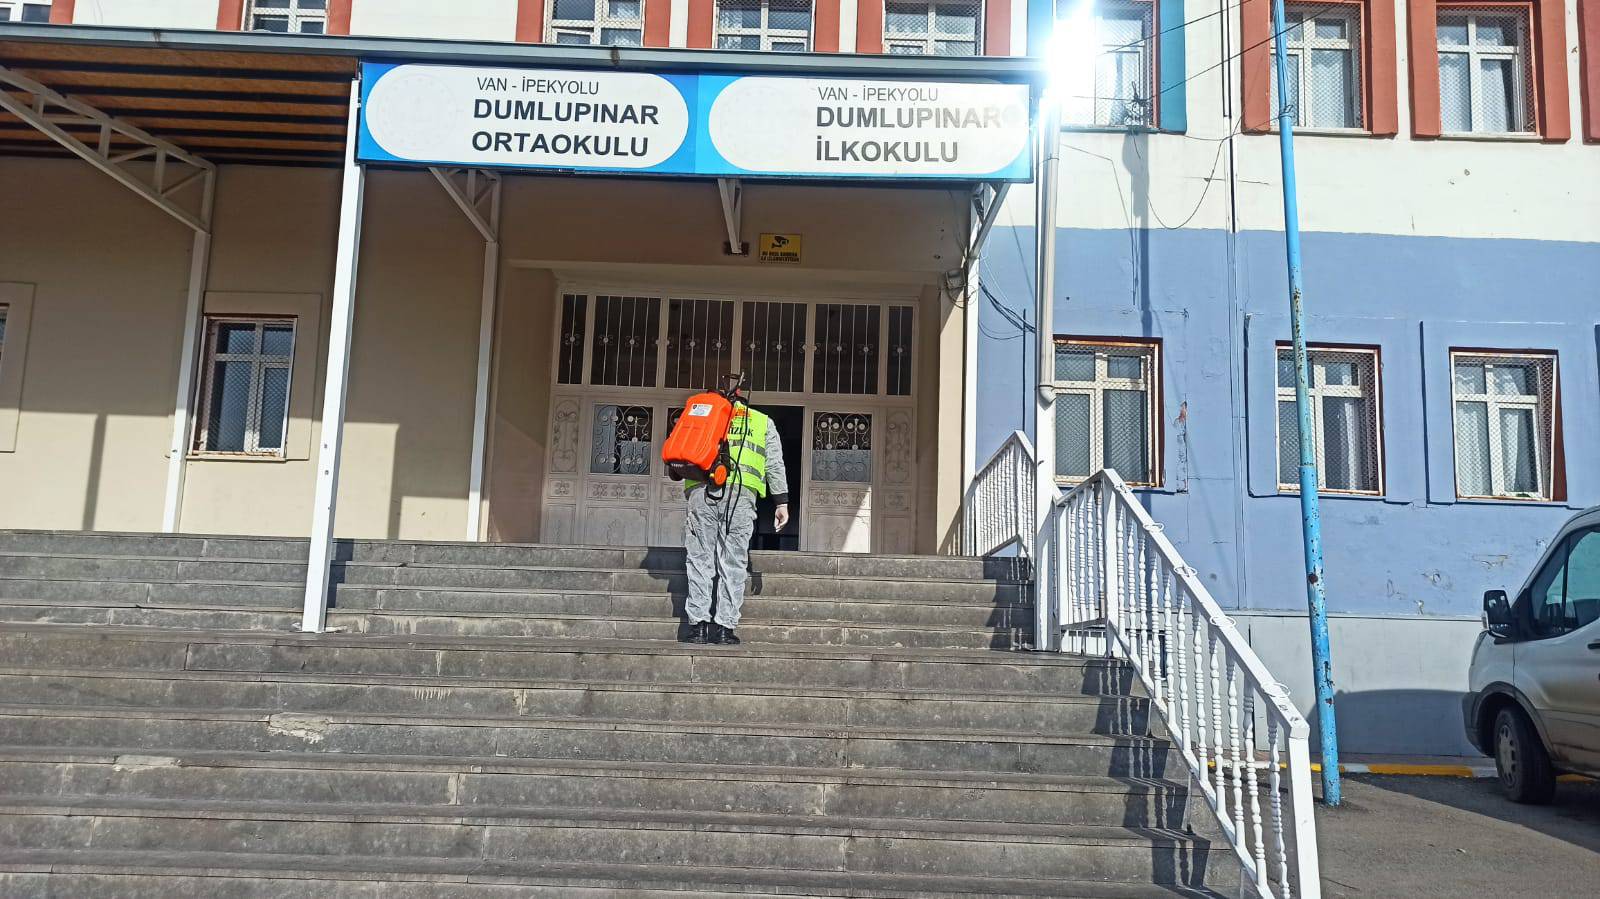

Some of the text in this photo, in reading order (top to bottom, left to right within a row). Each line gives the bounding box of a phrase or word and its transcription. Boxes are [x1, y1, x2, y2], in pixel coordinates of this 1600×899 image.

[476, 77, 507, 92] VAN
[521, 76, 599, 95] İPEKYOLU
[817, 86, 848, 101] VAN
[863, 84, 938, 102] İPEKYOLU
[473, 98, 659, 125] DUMLUPINAR
[816, 106, 1002, 129] DUMLUPINAR
[471, 131, 649, 157] ORTAOKULU
[816, 135, 958, 163] İLKOKULU
